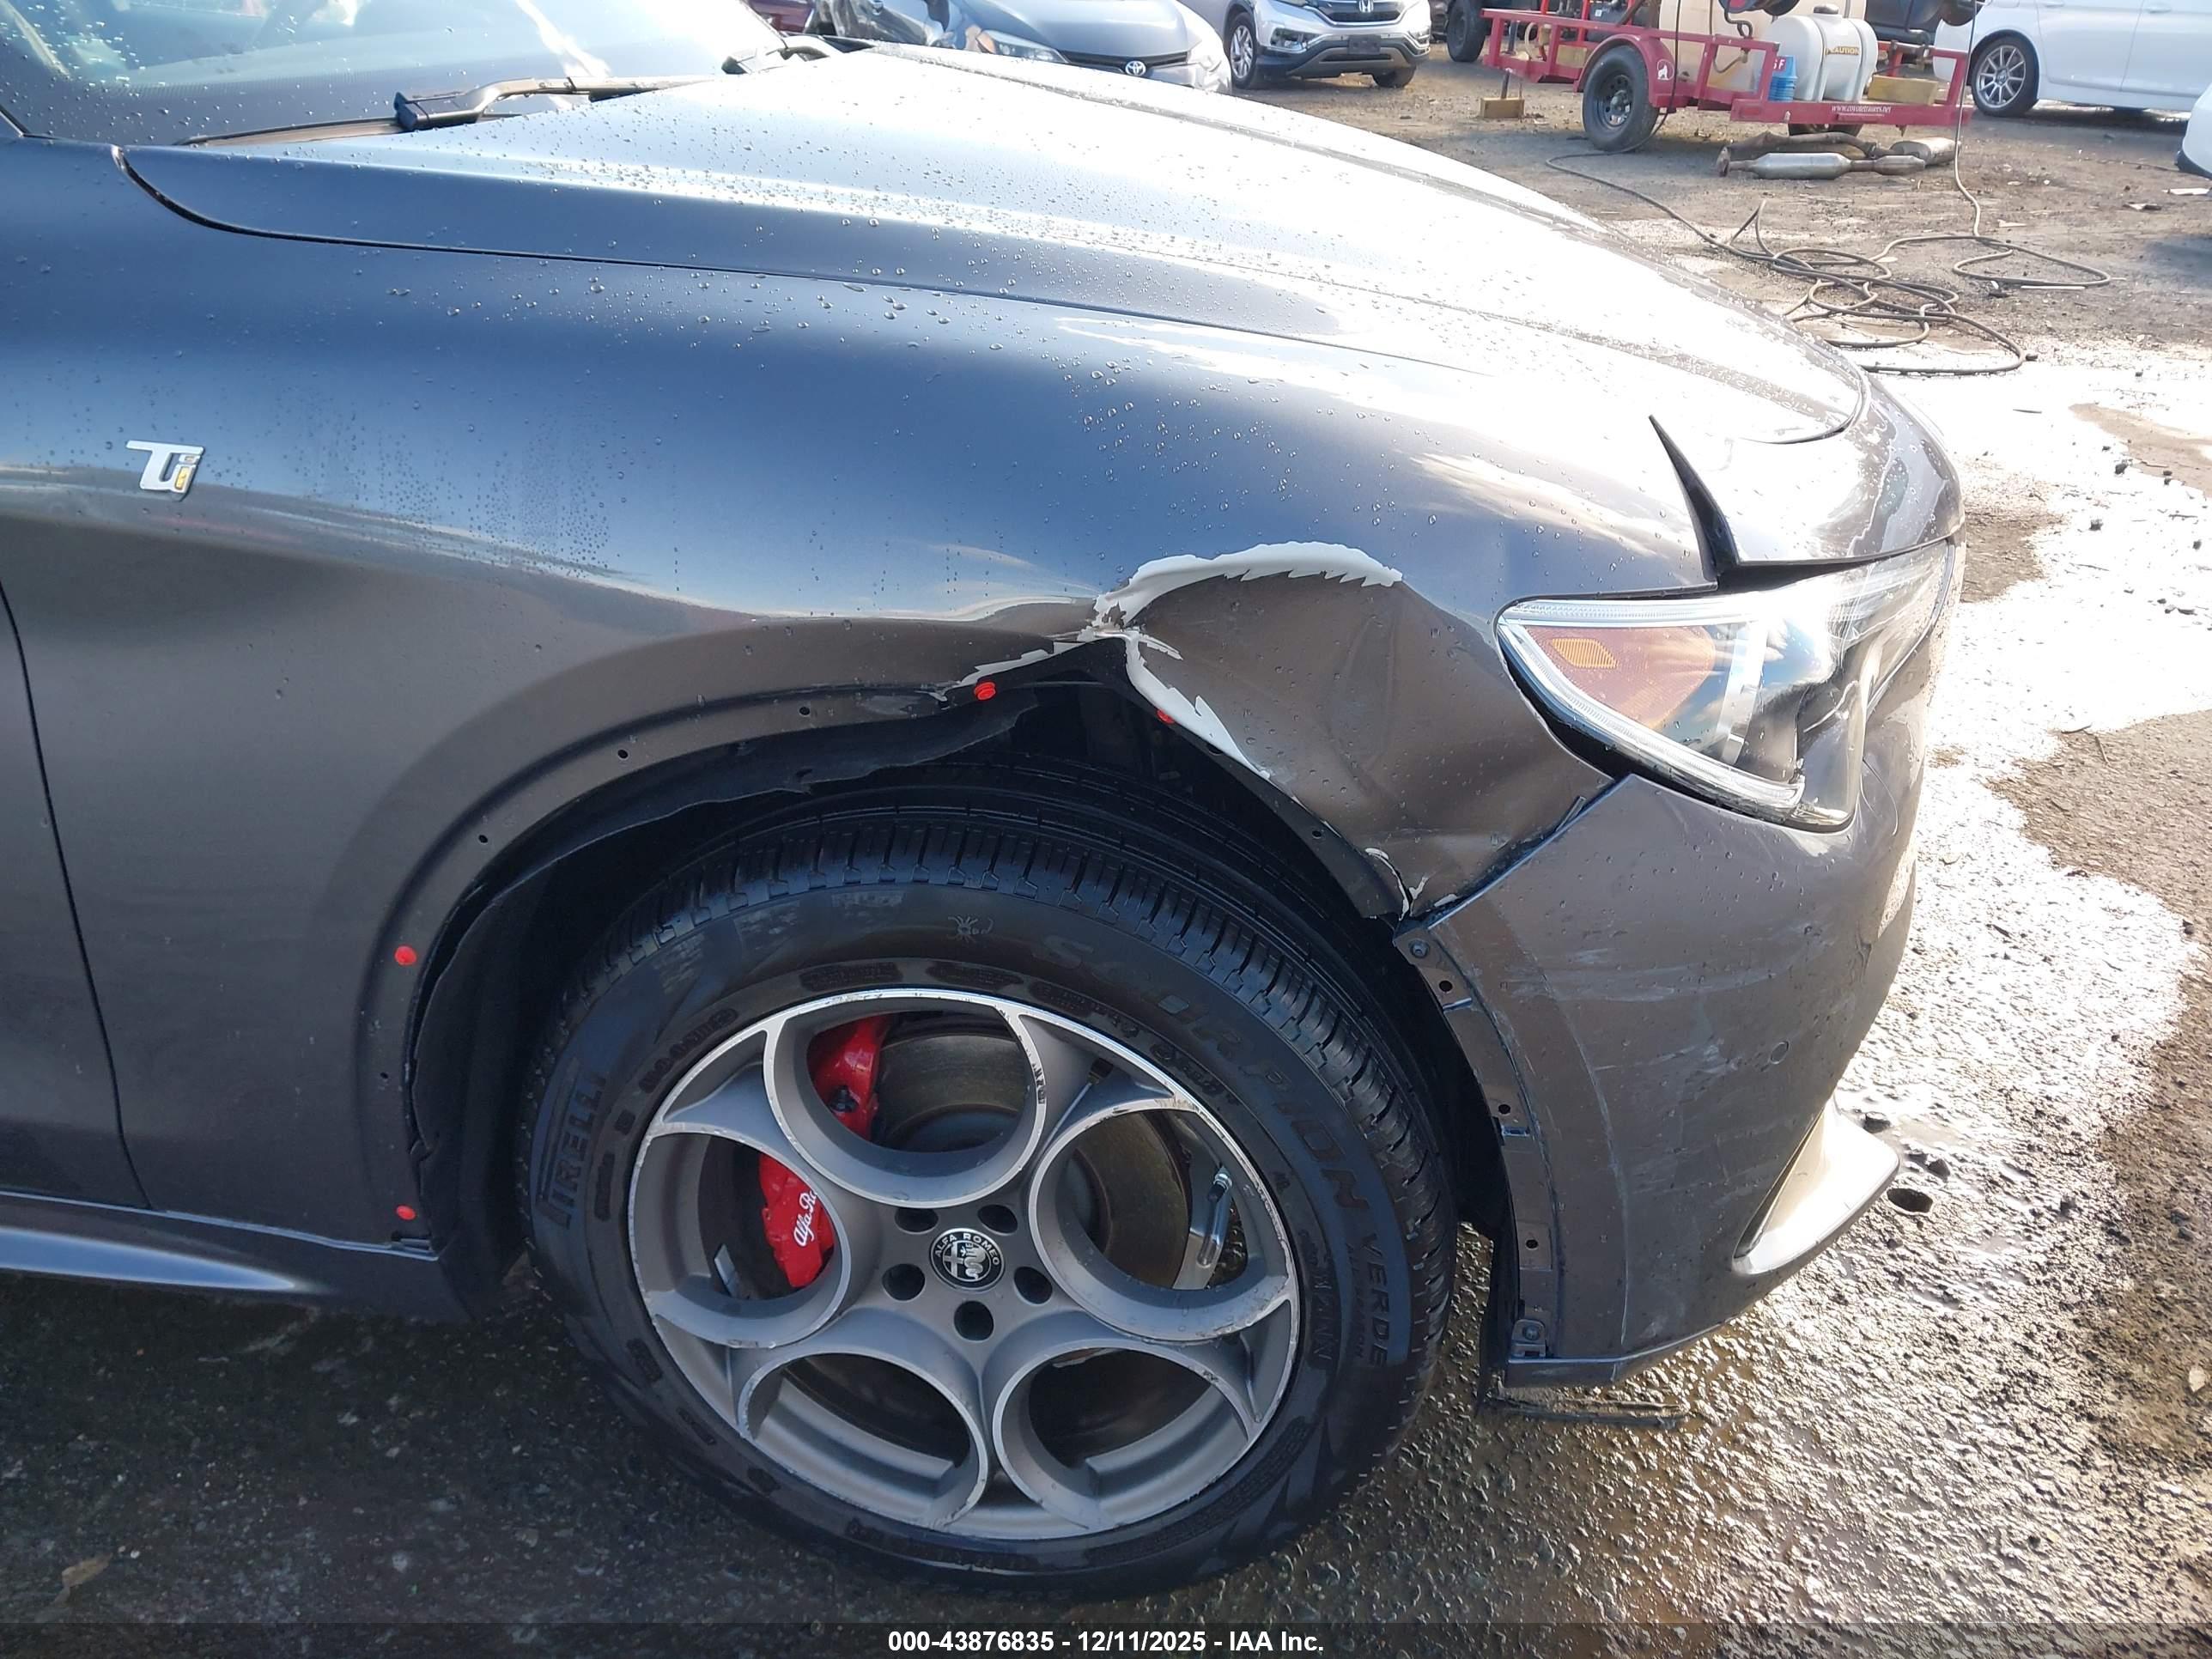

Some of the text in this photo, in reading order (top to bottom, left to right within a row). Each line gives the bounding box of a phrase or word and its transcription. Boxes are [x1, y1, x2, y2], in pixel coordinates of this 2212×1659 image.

[535, 1057, 607, 1231] PIRELLI
[793, 1212, 815, 1248] Alfa
[935, 1232, 1000, 1266] ALFA ROMEO
[1360, 1232, 1390, 1368] VERDE
